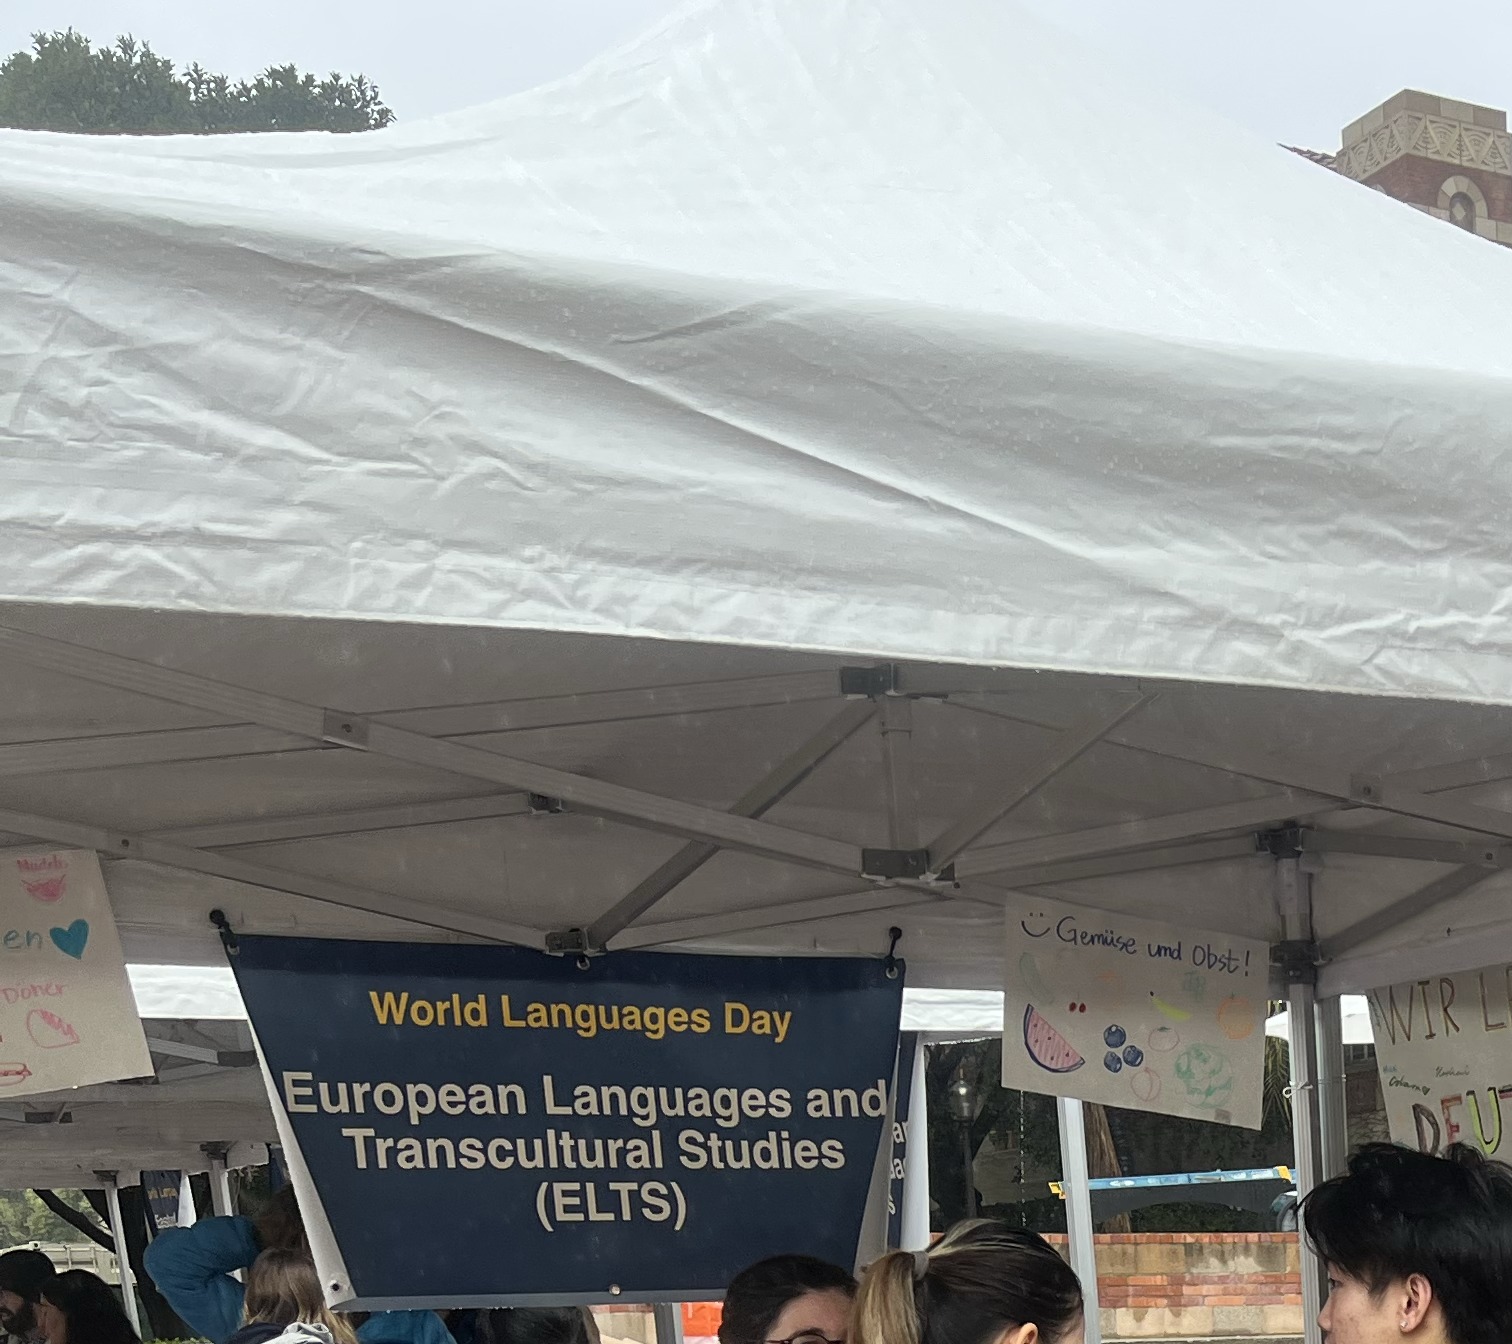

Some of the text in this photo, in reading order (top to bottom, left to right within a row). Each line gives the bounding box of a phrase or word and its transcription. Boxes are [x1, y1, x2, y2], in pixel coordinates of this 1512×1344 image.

[1056, 916, 1250, 977] Gemüse und Obst!
[369, 990, 792, 1043] World Languages Day
[1372, 976, 1460, 1046] WIR
[282, 1070, 887, 1128] European Languages and
[341, 1127, 664, 1170] Transcultural
[678, 1129, 846, 1170] Studies
[536, 1181, 687, 1232] (ELTS)
